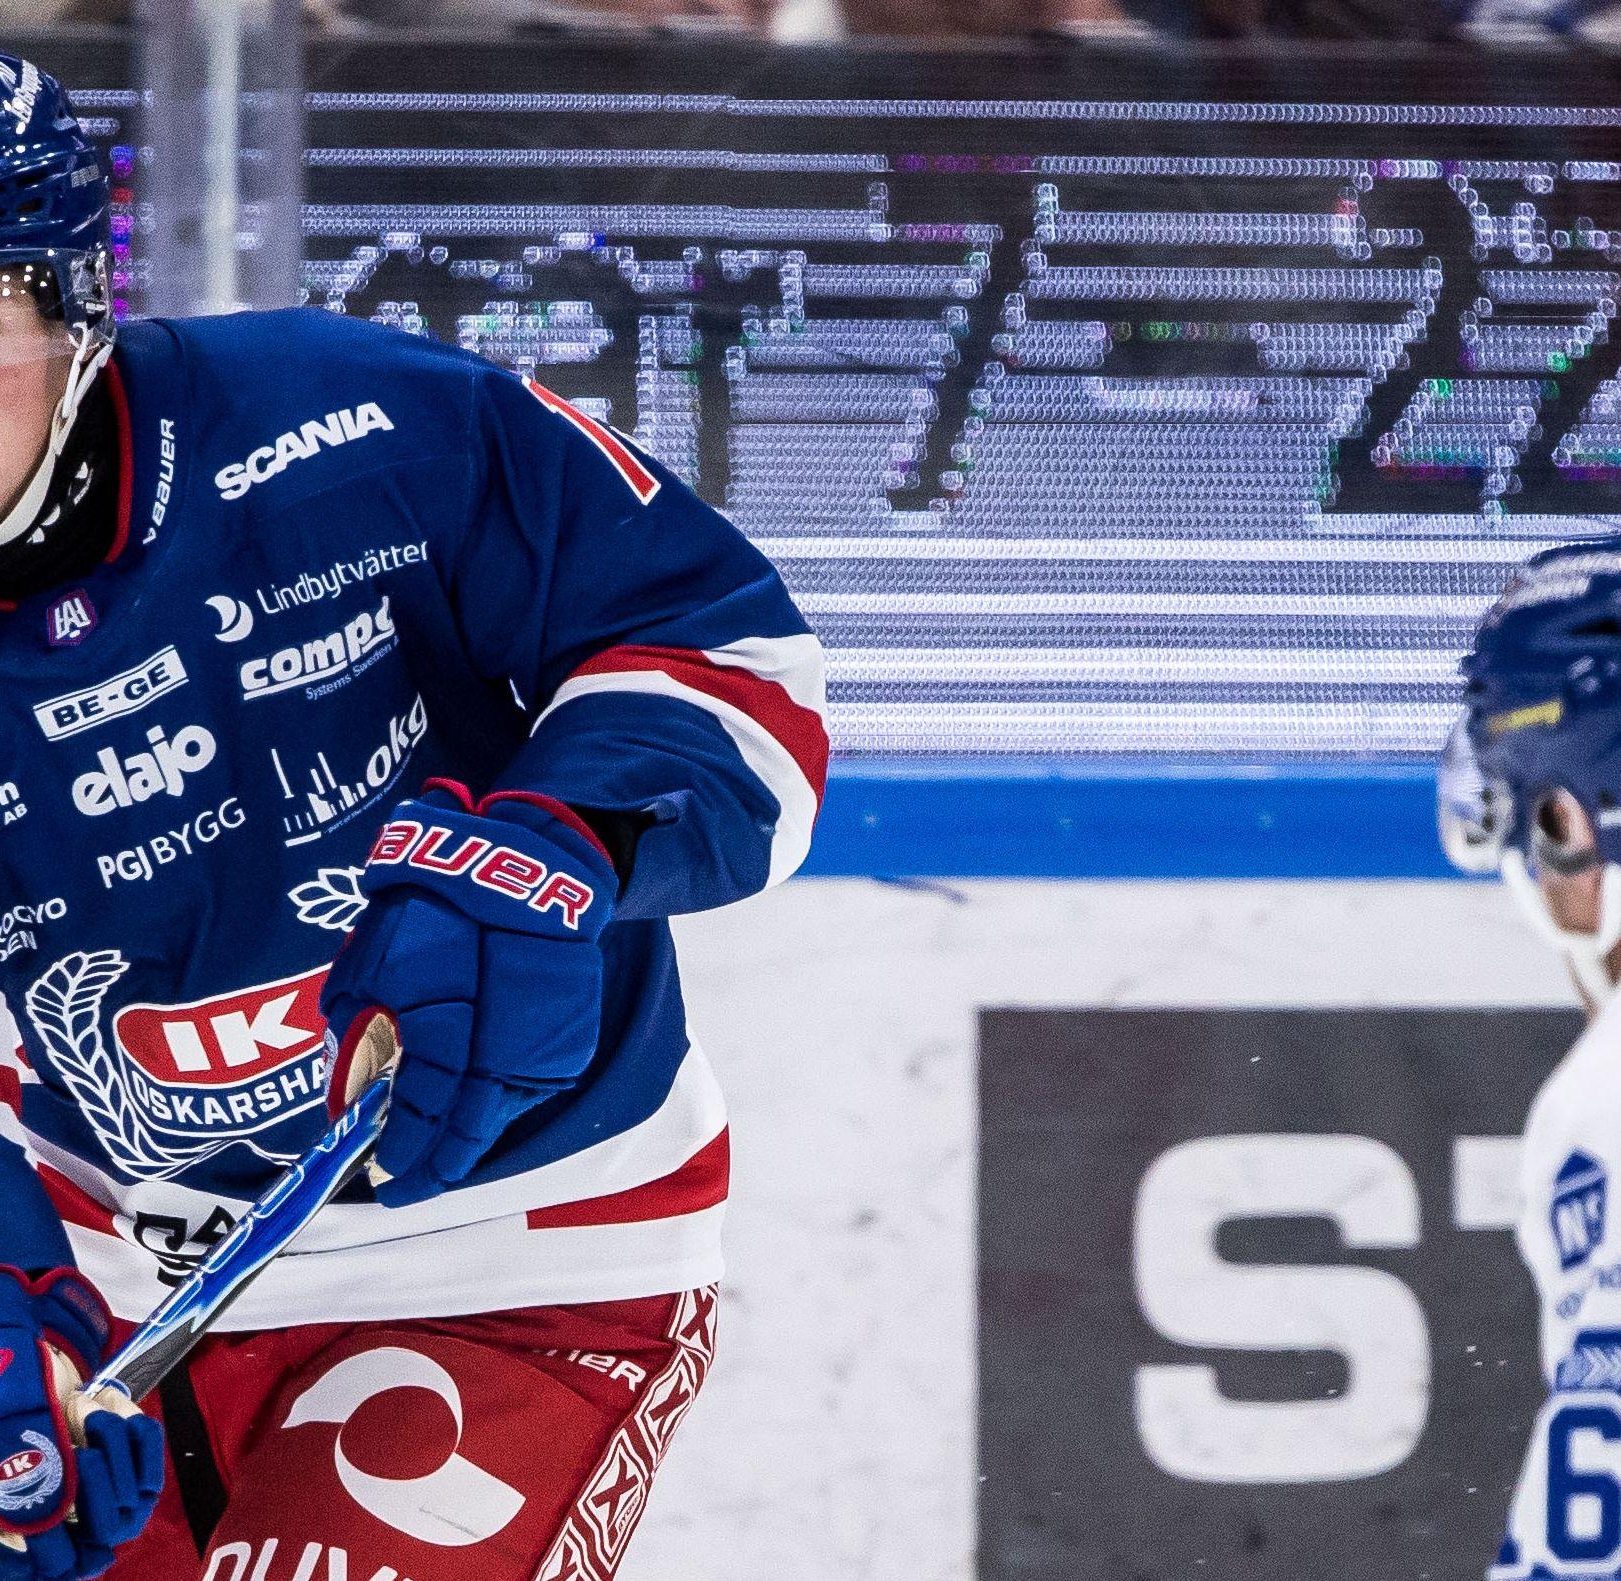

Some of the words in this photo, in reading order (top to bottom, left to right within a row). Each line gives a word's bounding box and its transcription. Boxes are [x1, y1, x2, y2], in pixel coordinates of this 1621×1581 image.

[214, 401, 394, 500] SCANIA
[51, 661, 171, 729] BE-GE
[306, 673, 352, 701] Systems
[72, 725, 217, 816] elajo
[3, 803, 28, 826] AB
[97, 846, 153, 889] PGJ
[150, 797, 246, 865] BYGG
[162, 989, 317, 1072] IK
[132, 1055, 331, 1126] OSKARSHA
[2, 1450, 33, 1479] IK
